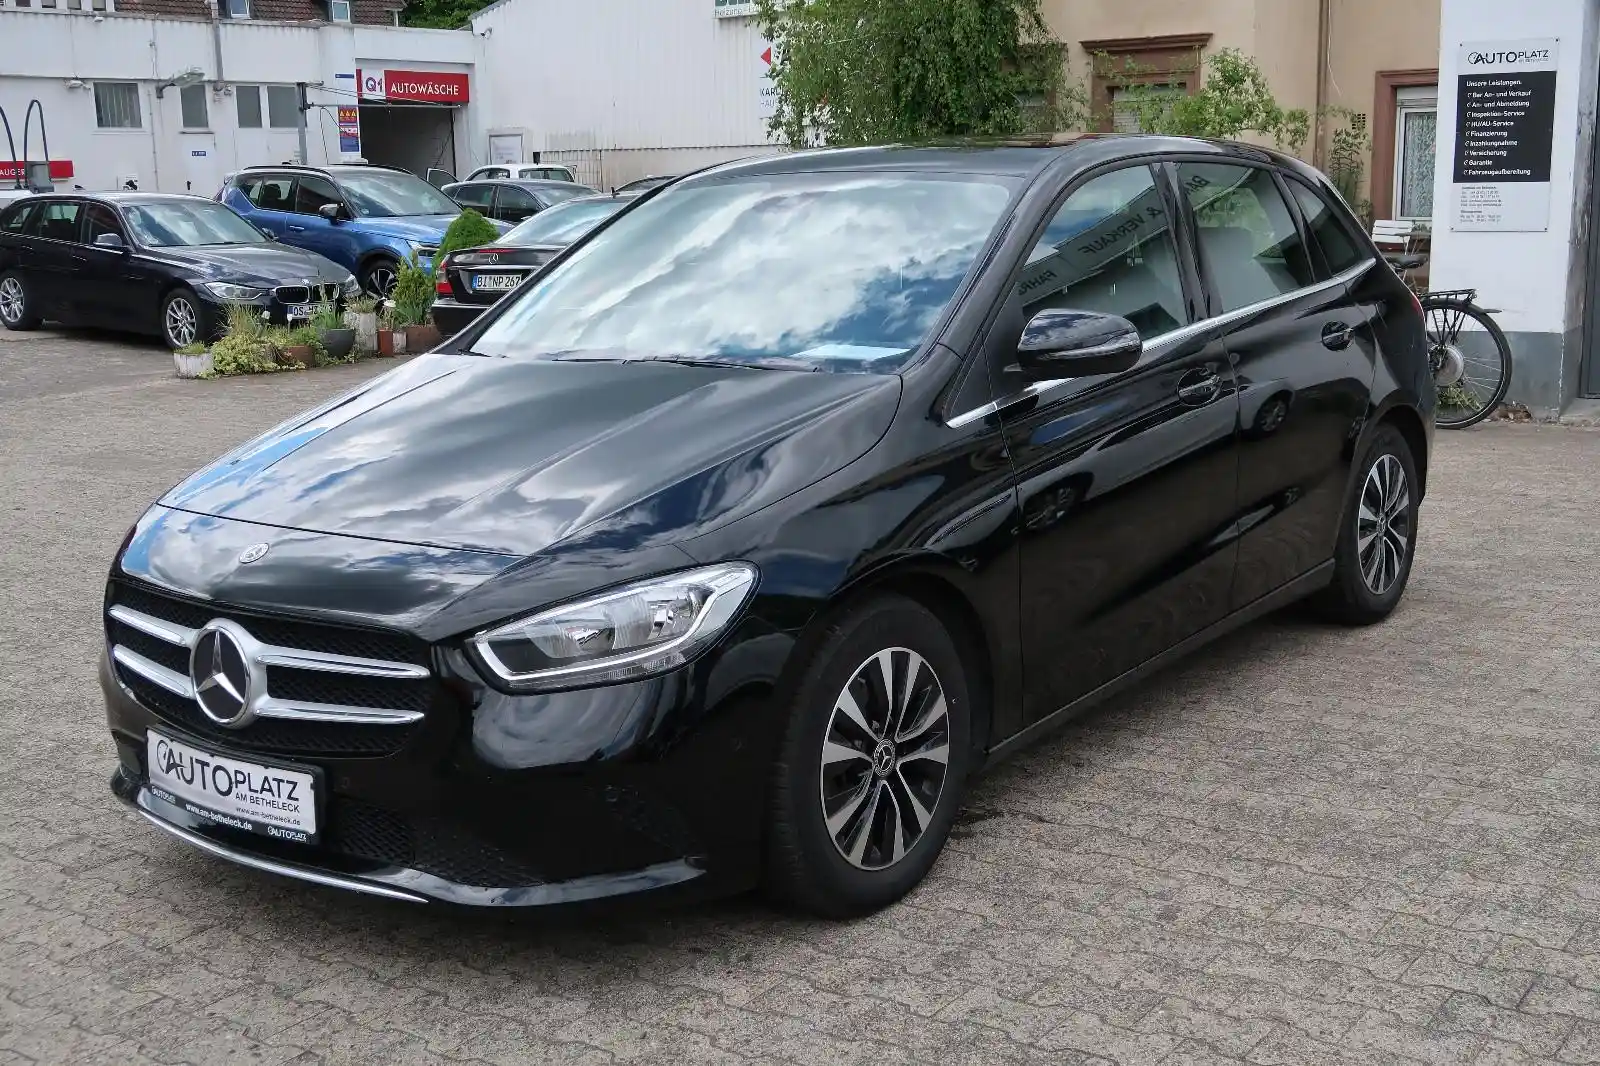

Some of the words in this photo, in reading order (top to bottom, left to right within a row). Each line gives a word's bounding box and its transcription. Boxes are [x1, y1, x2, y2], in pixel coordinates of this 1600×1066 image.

[1472, 49, 1549, 64] AUTOPLATZ
[365, 77, 383, 92] Q1
[390, 82, 459, 96] AUTOWÄSCHE
[1469, 139, 1518, 147] Inzahlungnahme
[1468, 168, 1531, 176] Fahrzeugaufbereitung
[477, 276, 487, 287] BI
[492, 276, 504, 287] NP
[505, 276, 521, 287] 267
[293, 306, 304, 316] OS
[164, 747, 300, 802] AUTOPLATZ
[235, 792, 248, 803] AM
[249, 796, 300, 814] BETHELECK
[185, 803, 253, 831] www.am-betheleck.de
[235, 807, 301, 826] www.am-betheleck.de
[271, 828, 307, 842] AUTOPLATZ
